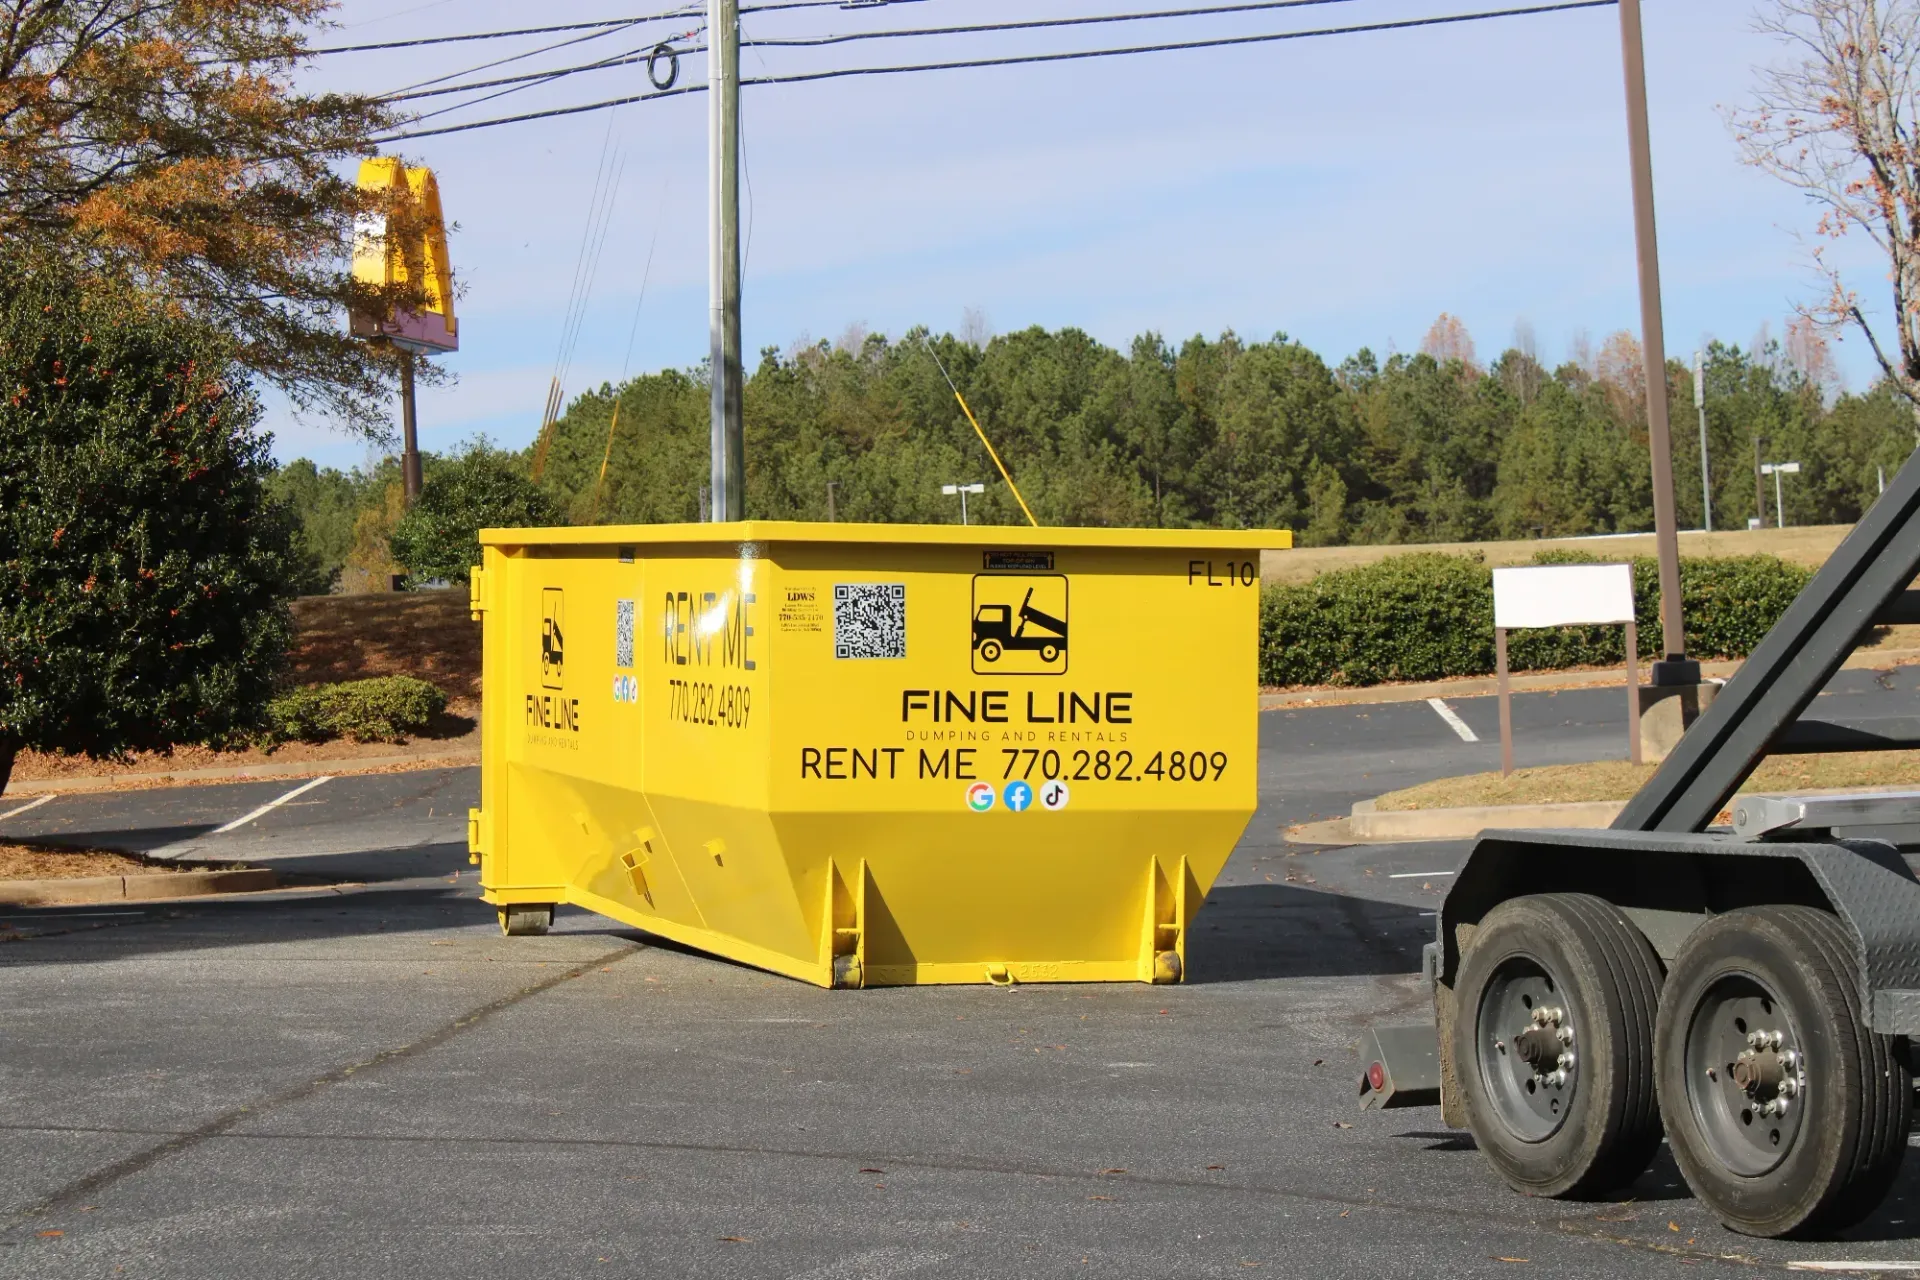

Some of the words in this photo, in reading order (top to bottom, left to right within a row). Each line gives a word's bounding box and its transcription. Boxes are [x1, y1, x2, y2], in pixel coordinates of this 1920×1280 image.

[1189, 561, 1254, 587] FL10
[787, 592, 815, 601] LDWS
[665, 592, 716, 667] RENT
[723, 592, 756, 671] ME
[526, 694, 551, 729] FINE
[554, 697, 580, 732] LINE
[670, 679, 751, 730] 770.282.4809
[902, 690, 1009, 723] FINE
[1026, 692, 1132, 724] LINE
[906, 730, 990, 742] DUMPING
[1002, 731, 1036, 742] AND
[1048, 731, 1128, 742] RENTALS
[802, 748, 905, 779] RENT
[919, 748, 977, 779] ME
[1001, 749, 1228, 781] 770.282.4809
